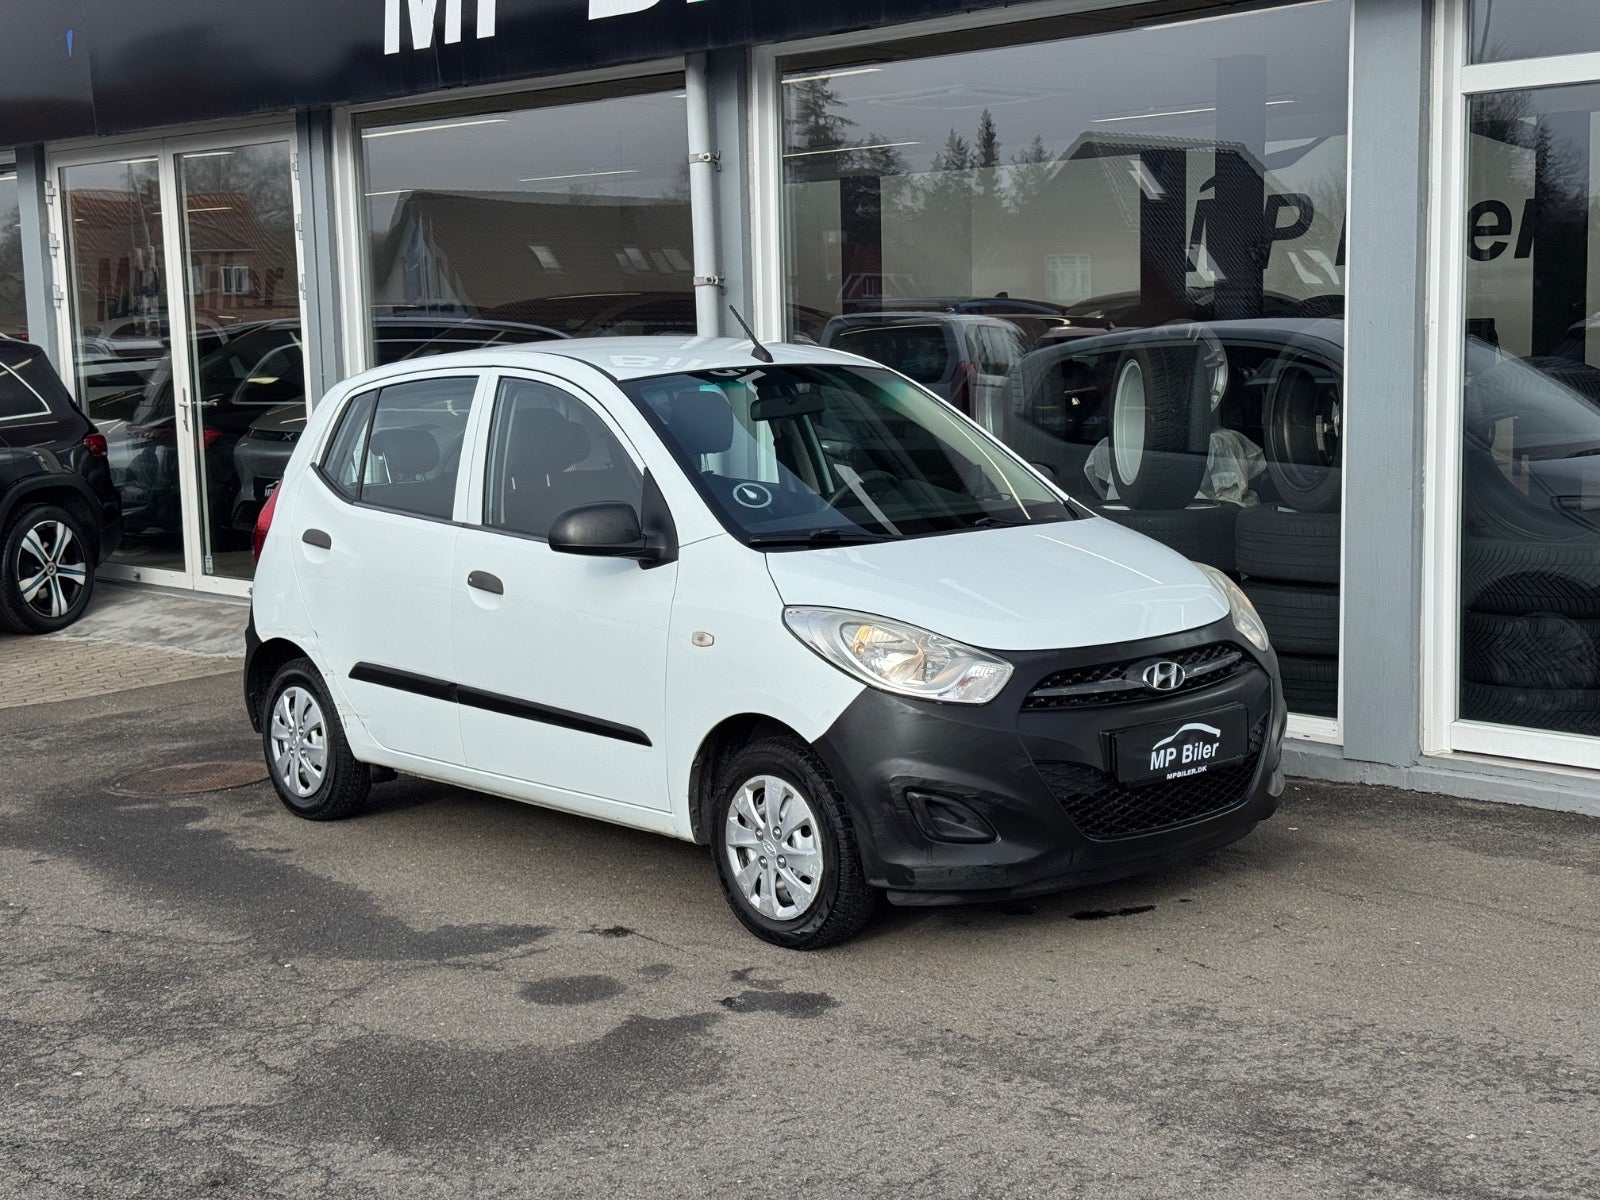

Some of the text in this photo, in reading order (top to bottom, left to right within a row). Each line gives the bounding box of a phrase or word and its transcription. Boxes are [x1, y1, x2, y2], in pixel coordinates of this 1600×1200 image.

[1150, 741, 1220, 771] MP Biler
[1166, 765, 1208, 780] MPBILER.DK
